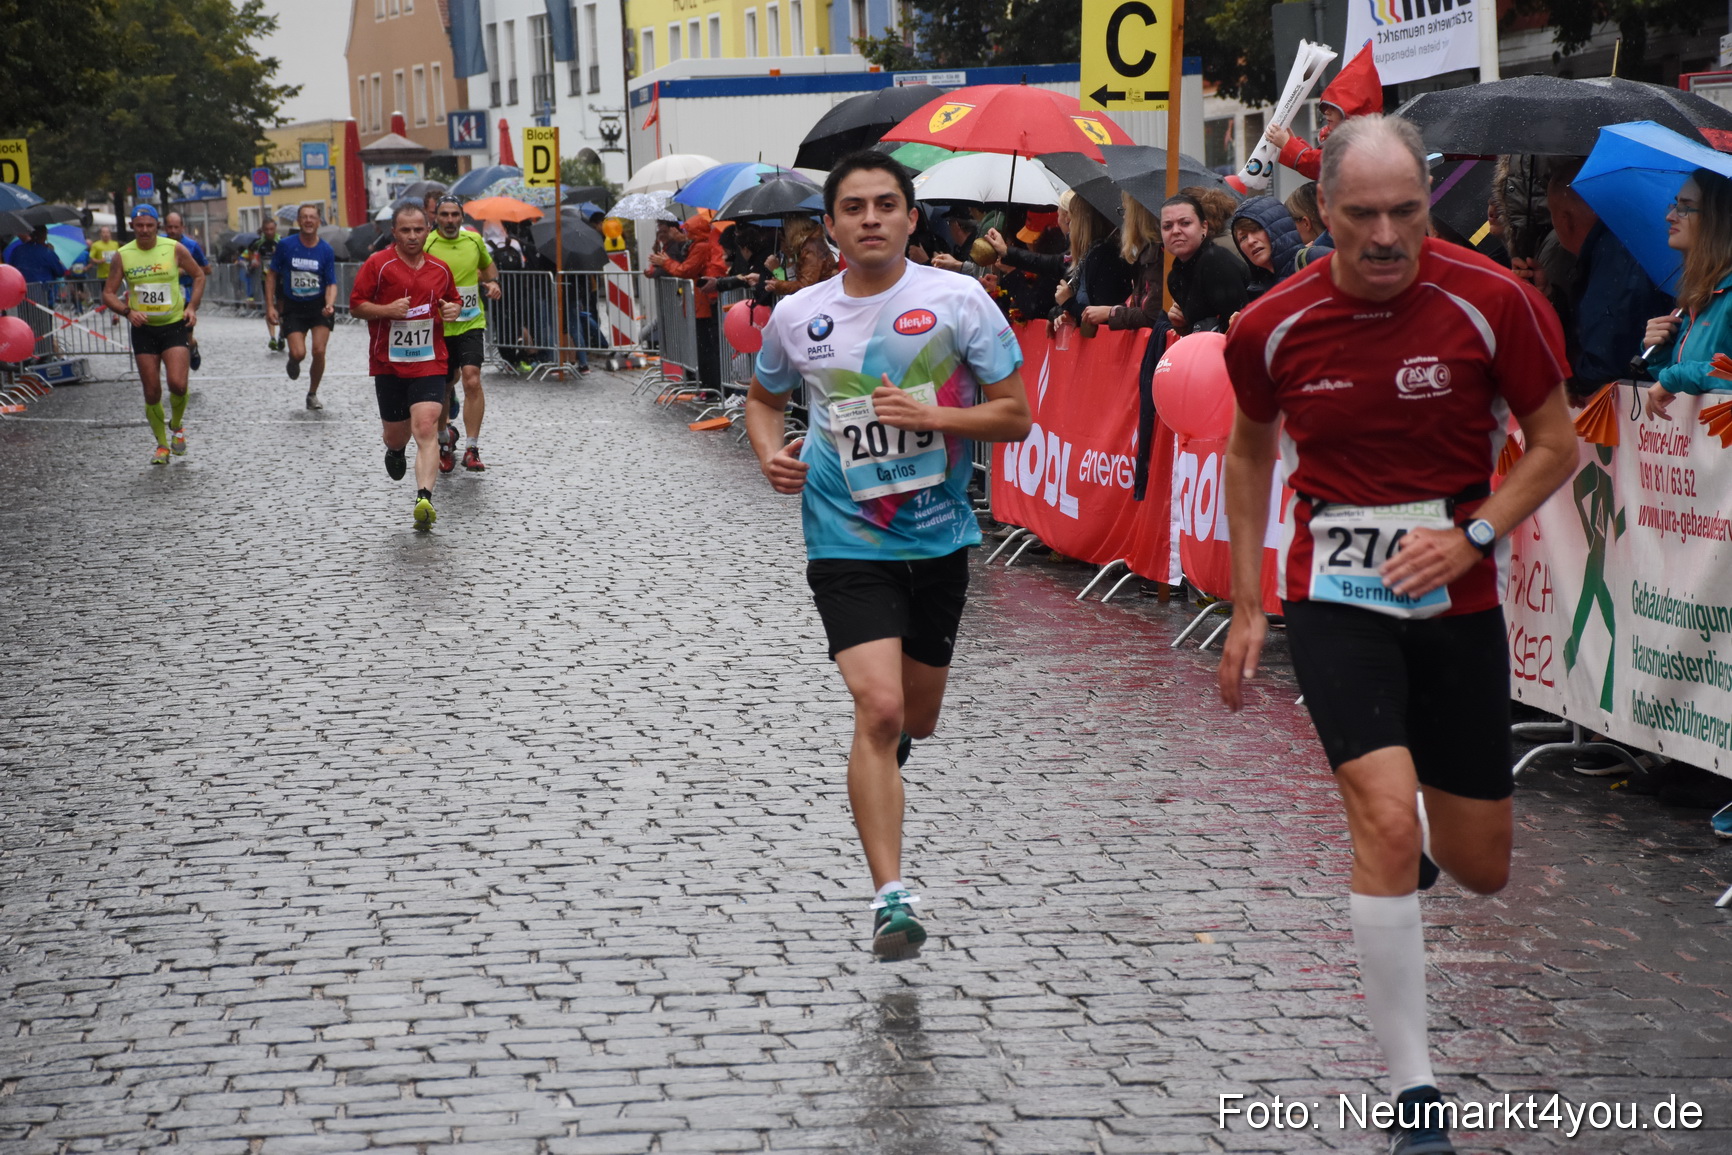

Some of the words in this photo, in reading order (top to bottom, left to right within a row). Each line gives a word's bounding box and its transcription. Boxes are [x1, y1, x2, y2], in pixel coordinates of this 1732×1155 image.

[1106, 1, 1157, 77] C
[452, 115, 483, 141] KL
[526, 129, 555, 141] Block
[0, 142, 23, 154] ock
[533, 145, 551, 174] D
[0, 158, 20, 185] D
[254, 186, 269, 194] TAXI
[142, 291, 165, 304] 284
[394, 329, 431, 346] 2417
[807, 344, 835, 356] PARTL
[808, 352, 835, 361] Neumarkt
[1638, 423, 1691, 457] Service-Line:
[876, 464, 916, 481] Carlos
[1671, 467, 1683, 496] 63
[1684, 469, 1697, 498] 52
[916, 508, 956, 530] Stadtlauf
